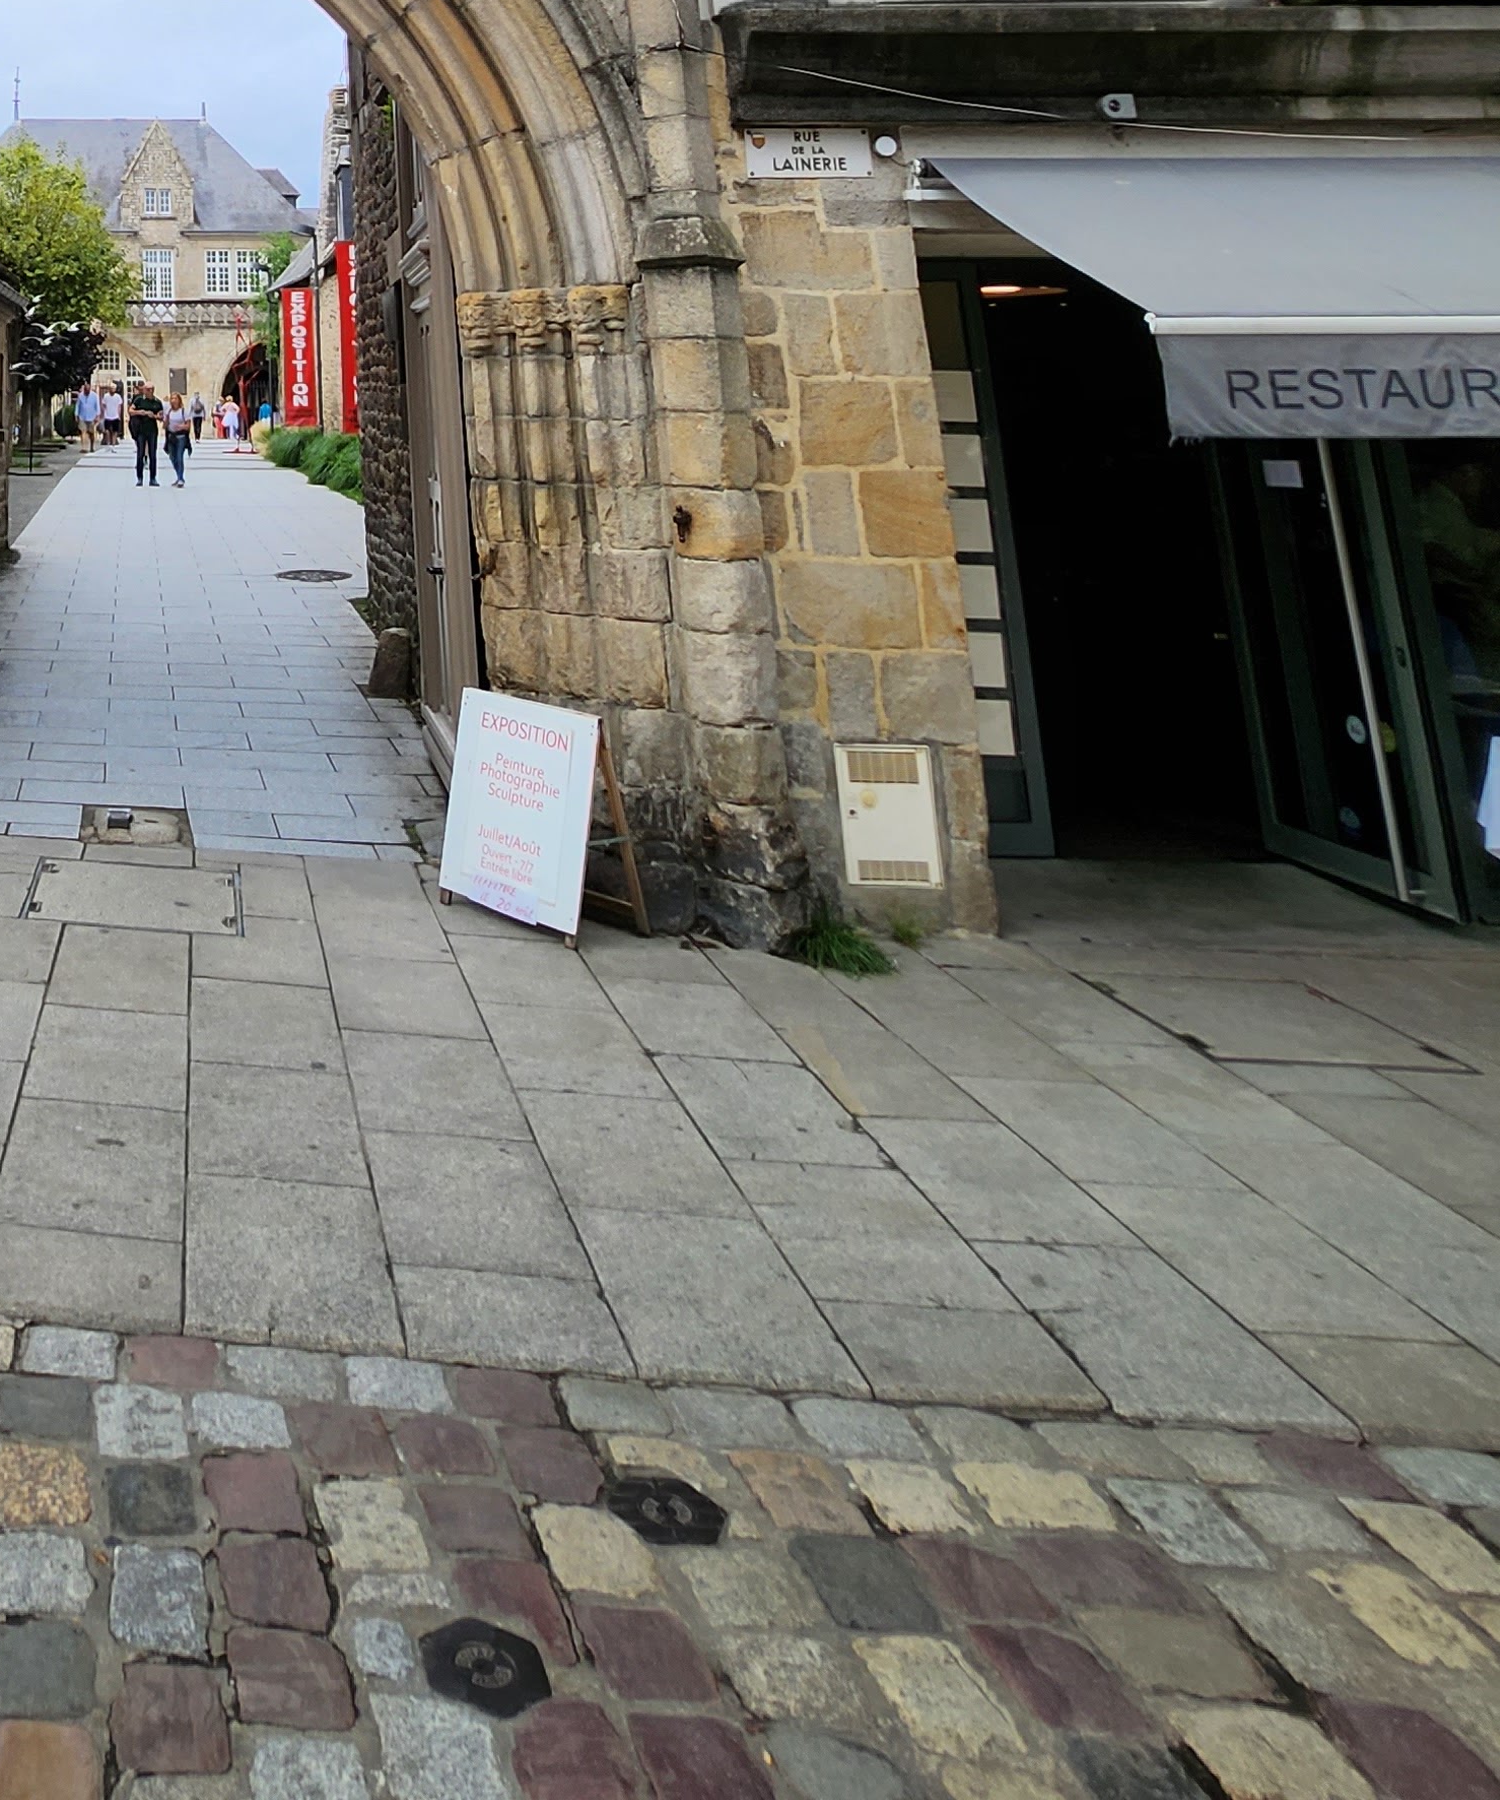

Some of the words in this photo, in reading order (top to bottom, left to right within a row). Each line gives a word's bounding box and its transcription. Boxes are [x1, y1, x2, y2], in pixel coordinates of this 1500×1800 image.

[791, 146, 804, 155] DE
[811, 146, 826, 155] LA
[793, 131, 820, 142] RUE
[772, 157, 848, 171] LAINERIE
[290, 291, 309, 407] EXPOSITION
[1225, 368, 1500, 410] RESTAUR
[481, 711, 569, 752] EXPOSITION
[480, 762, 560, 799] Photographie
[495, 752, 545, 779] Peinture
[488, 782, 544, 812] Sculpture
[478, 825, 541, 857] Juillet/Août
[482, 844, 512, 864] Ouvert
[520, 860, 534, 874] 7/7
[512, 869, 533, 886] libre
